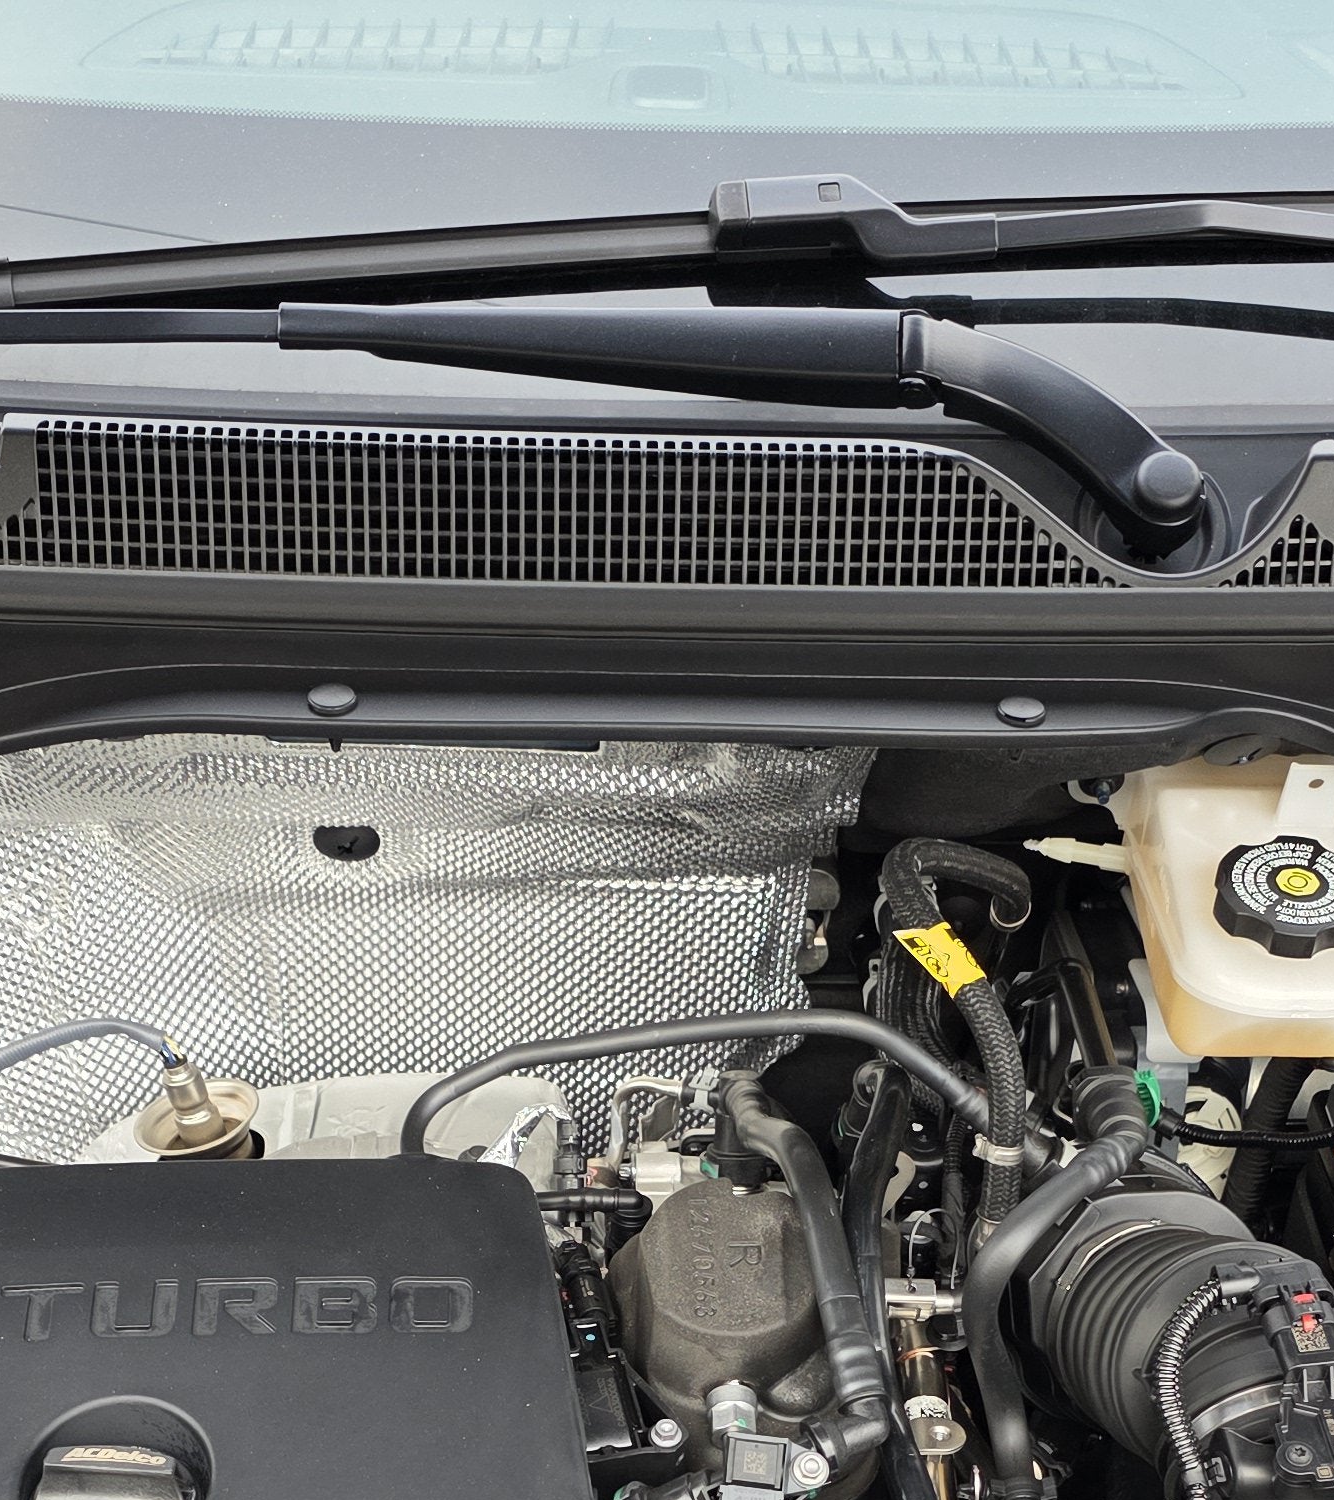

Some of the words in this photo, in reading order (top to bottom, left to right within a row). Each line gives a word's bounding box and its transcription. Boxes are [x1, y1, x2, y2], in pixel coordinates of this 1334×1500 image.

[1264, 842, 1288, 851] FLUID
[1294, 843, 1313, 852] DOT
[728, 1239, 763, 1268] R
[1, 1276, 474, 1342] TURBO
[62, 1447, 167, 1465] ACDelco
